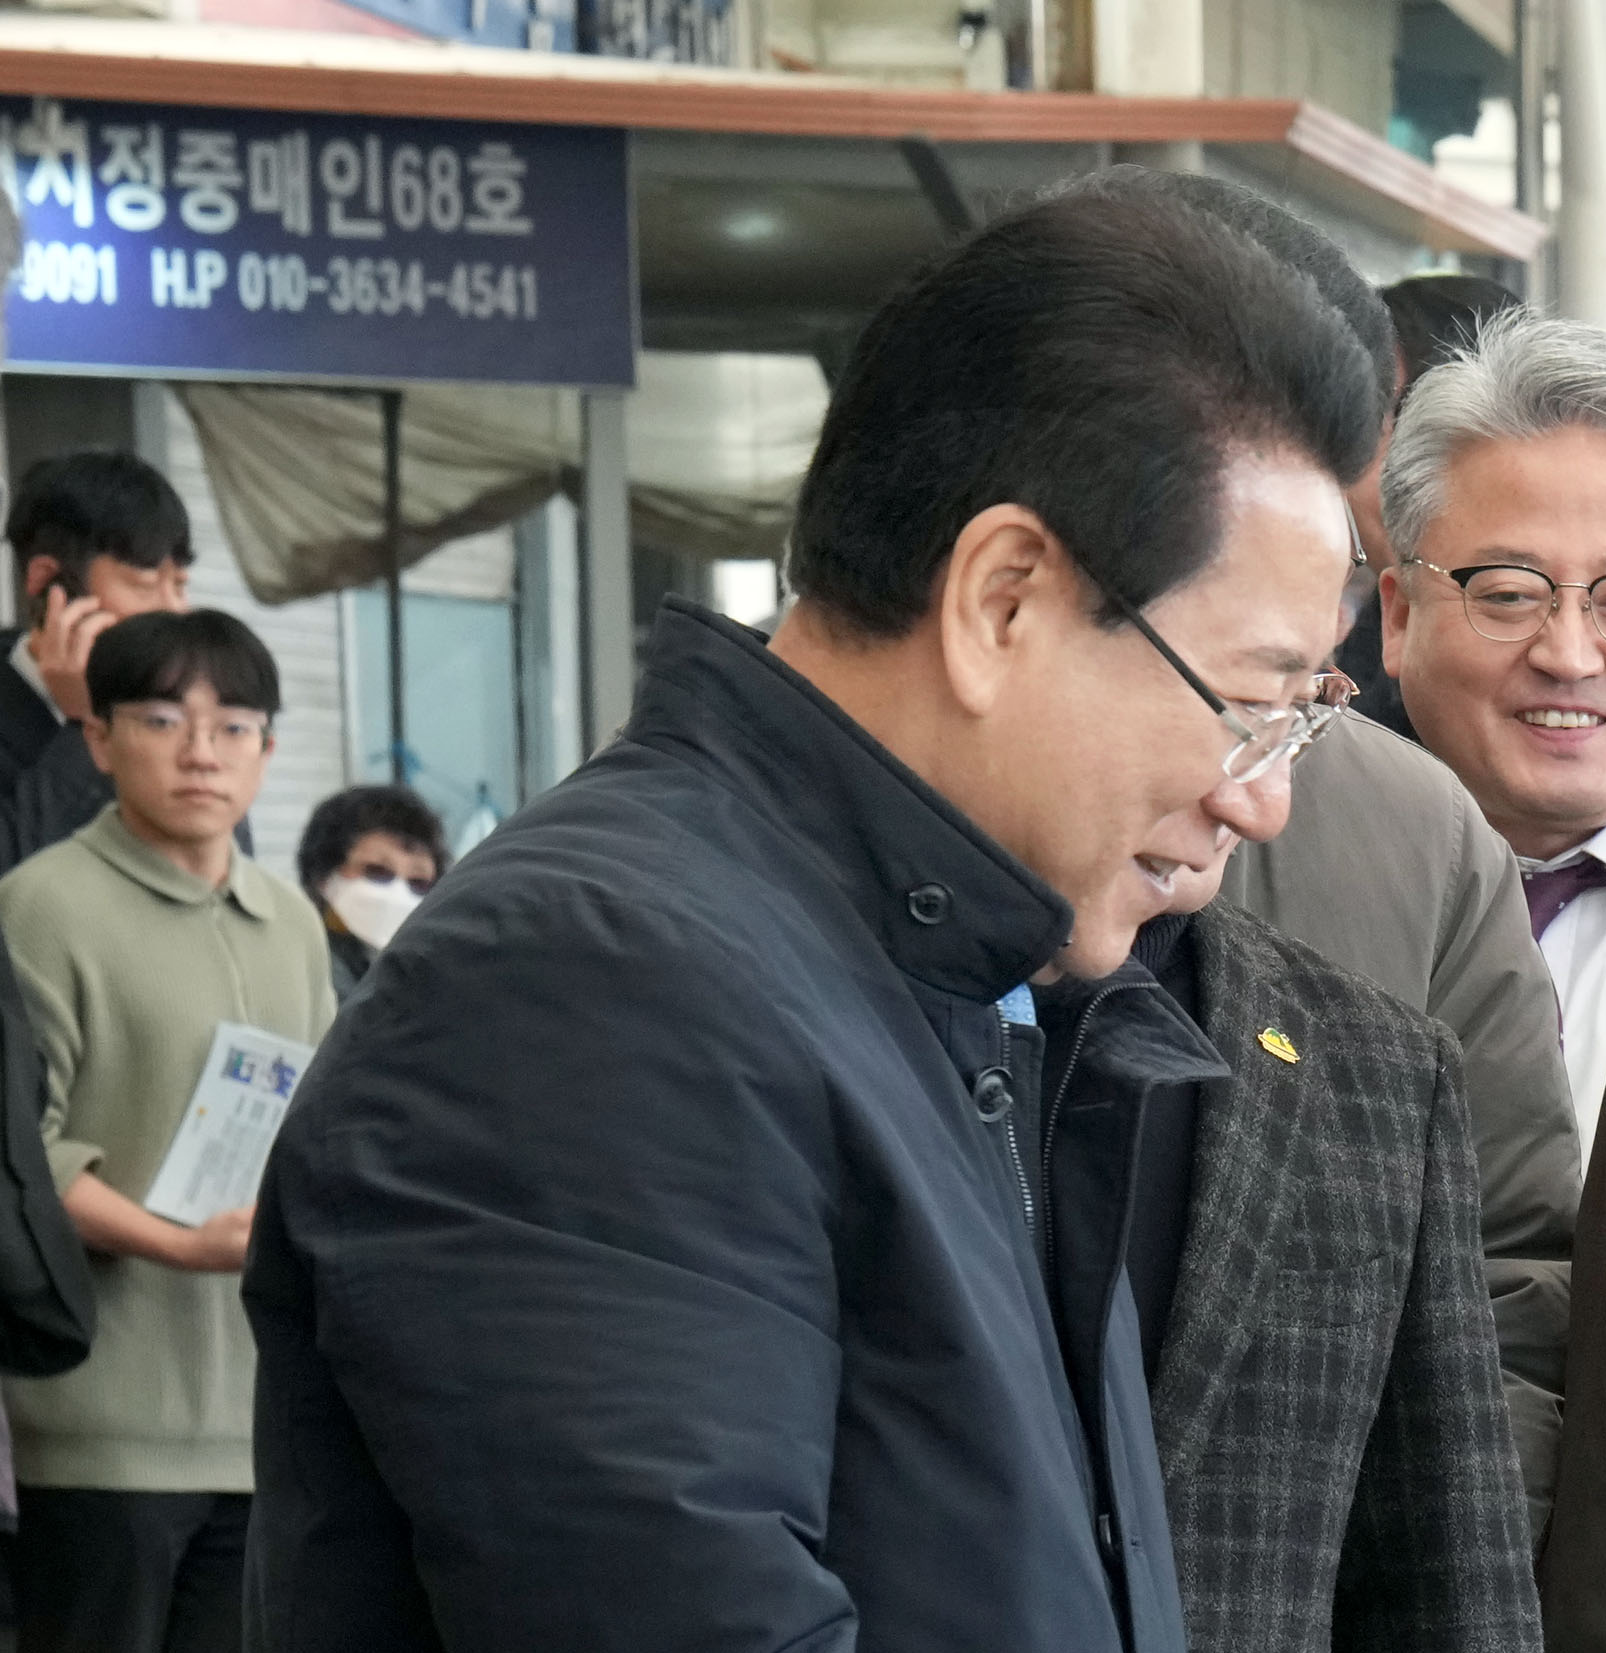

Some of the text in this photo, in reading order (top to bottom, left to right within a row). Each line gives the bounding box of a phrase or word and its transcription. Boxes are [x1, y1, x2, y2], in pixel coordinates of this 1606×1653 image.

[0, 112, 534, 238] 지정중매인68호
[151, 247, 228, 309] H.P
[237, 251, 538, 323] 010-3634-4541
